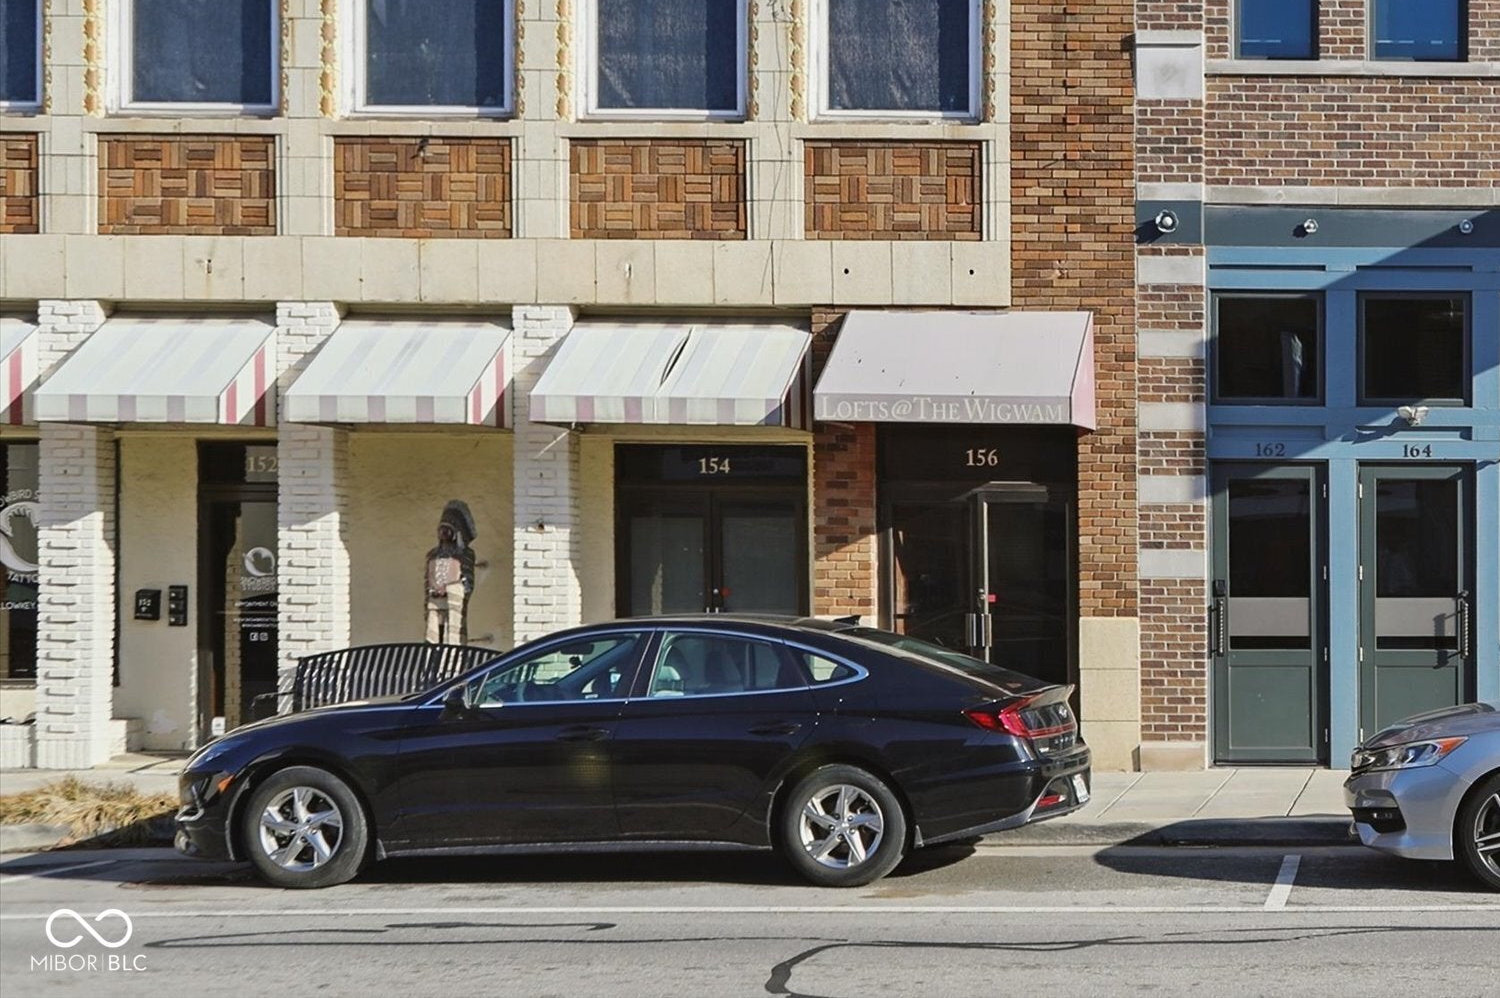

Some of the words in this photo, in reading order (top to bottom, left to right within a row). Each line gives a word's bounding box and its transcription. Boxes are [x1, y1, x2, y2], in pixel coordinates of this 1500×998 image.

[963, 398, 1063, 422] WIGWAM
[1256, 442, 1286, 457] 162
[1402, 444, 1432, 458] 164
[246, 456, 277, 472] 152
[698, 457, 730, 474] 154
[965, 449, 998, 467] 156
